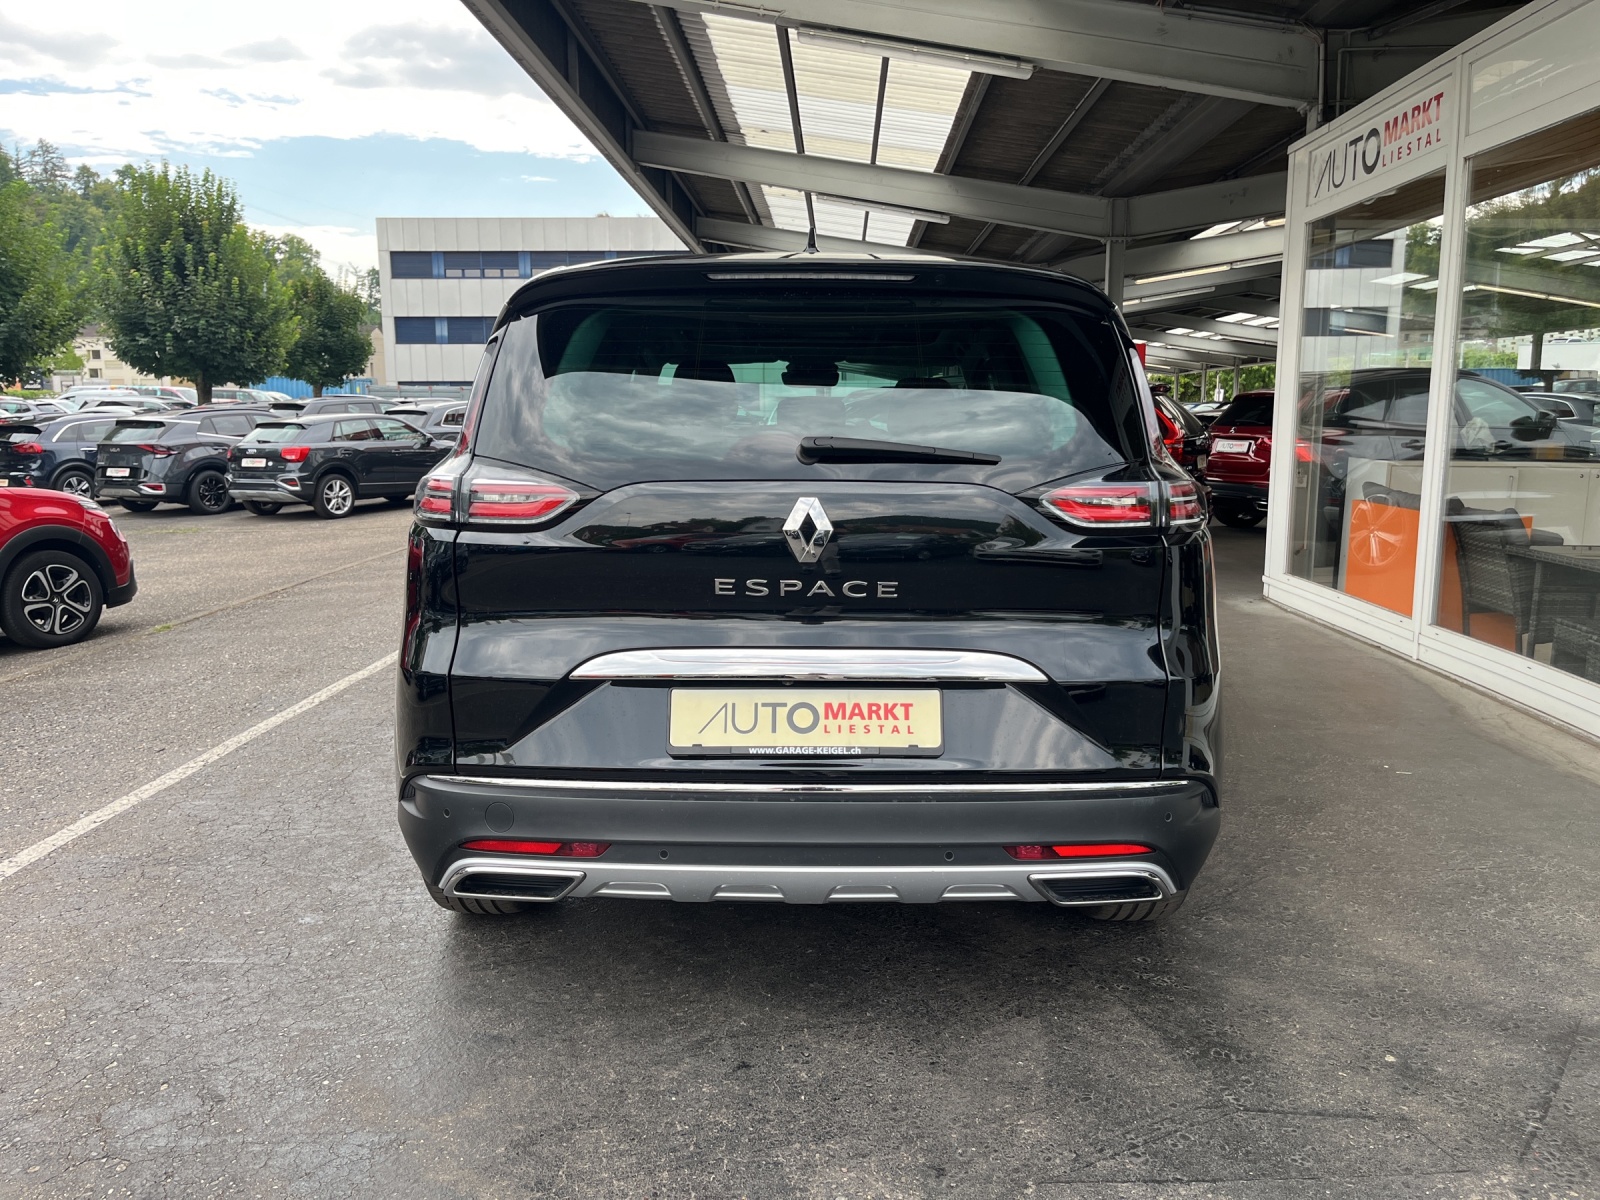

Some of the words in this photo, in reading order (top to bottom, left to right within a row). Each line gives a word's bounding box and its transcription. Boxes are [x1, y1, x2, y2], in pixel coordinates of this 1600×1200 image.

[1314, 127, 1381, 198] AUTO
[1383, 92, 1444, 147] MARKT
[1382, 128, 1441, 167] LIESTAL
[714, 578, 899, 598] ESPACE
[698, 701, 820, 735] AUTO
[824, 702, 914, 721] MARKT
[824, 724, 914, 735] LIESTAL
[749, 746, 861, 755] www.GARAGE-KEIGEL.ch
